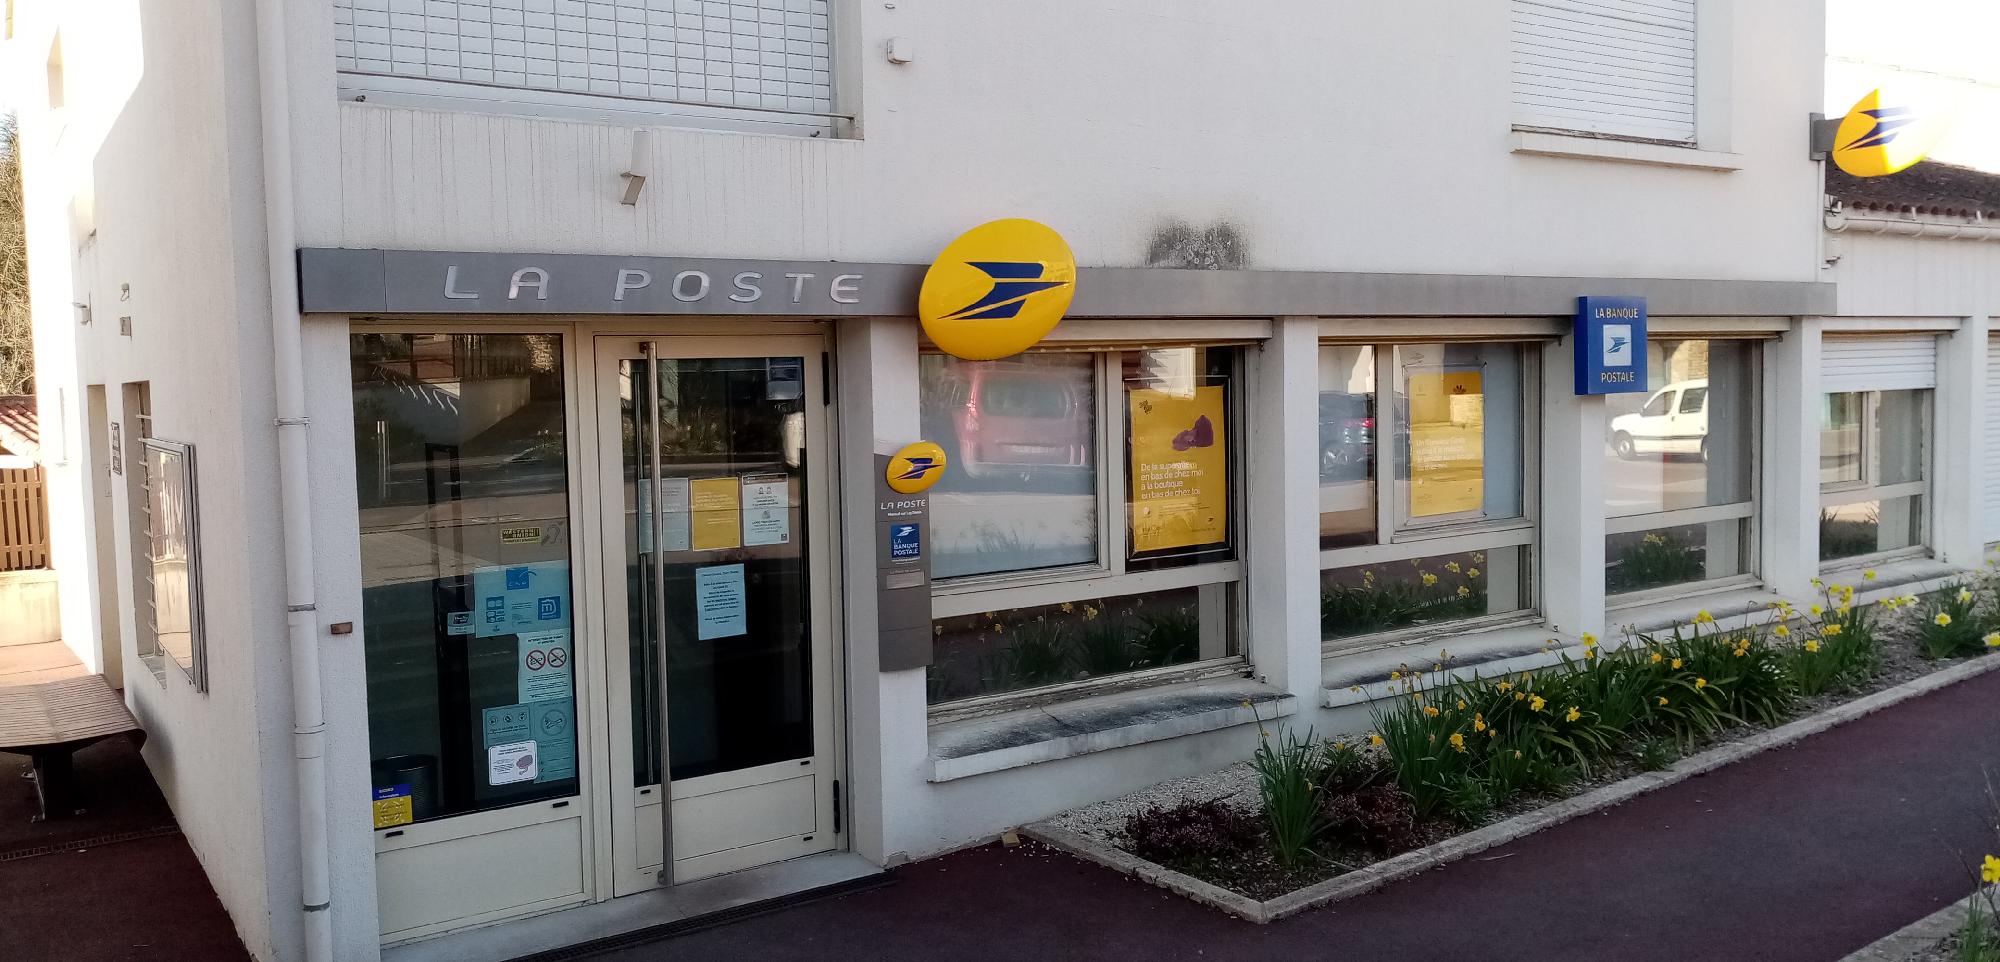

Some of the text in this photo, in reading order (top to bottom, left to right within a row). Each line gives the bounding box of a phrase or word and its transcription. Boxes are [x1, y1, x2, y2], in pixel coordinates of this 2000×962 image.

[443, 264, 865, 305] LA POSTE
[1595, 307, 1639, 320] LA BANQUE
[1601, 371, 1635, 383] POSTALE
[1165, 470, 1173, 478] de
[1174, 469, 1190, 477] chez
[1154, 480, 1183, 489] boutique
[880, 499, 926, 510] LA POSTE
[893, 548, 919, 556] POSTALE
